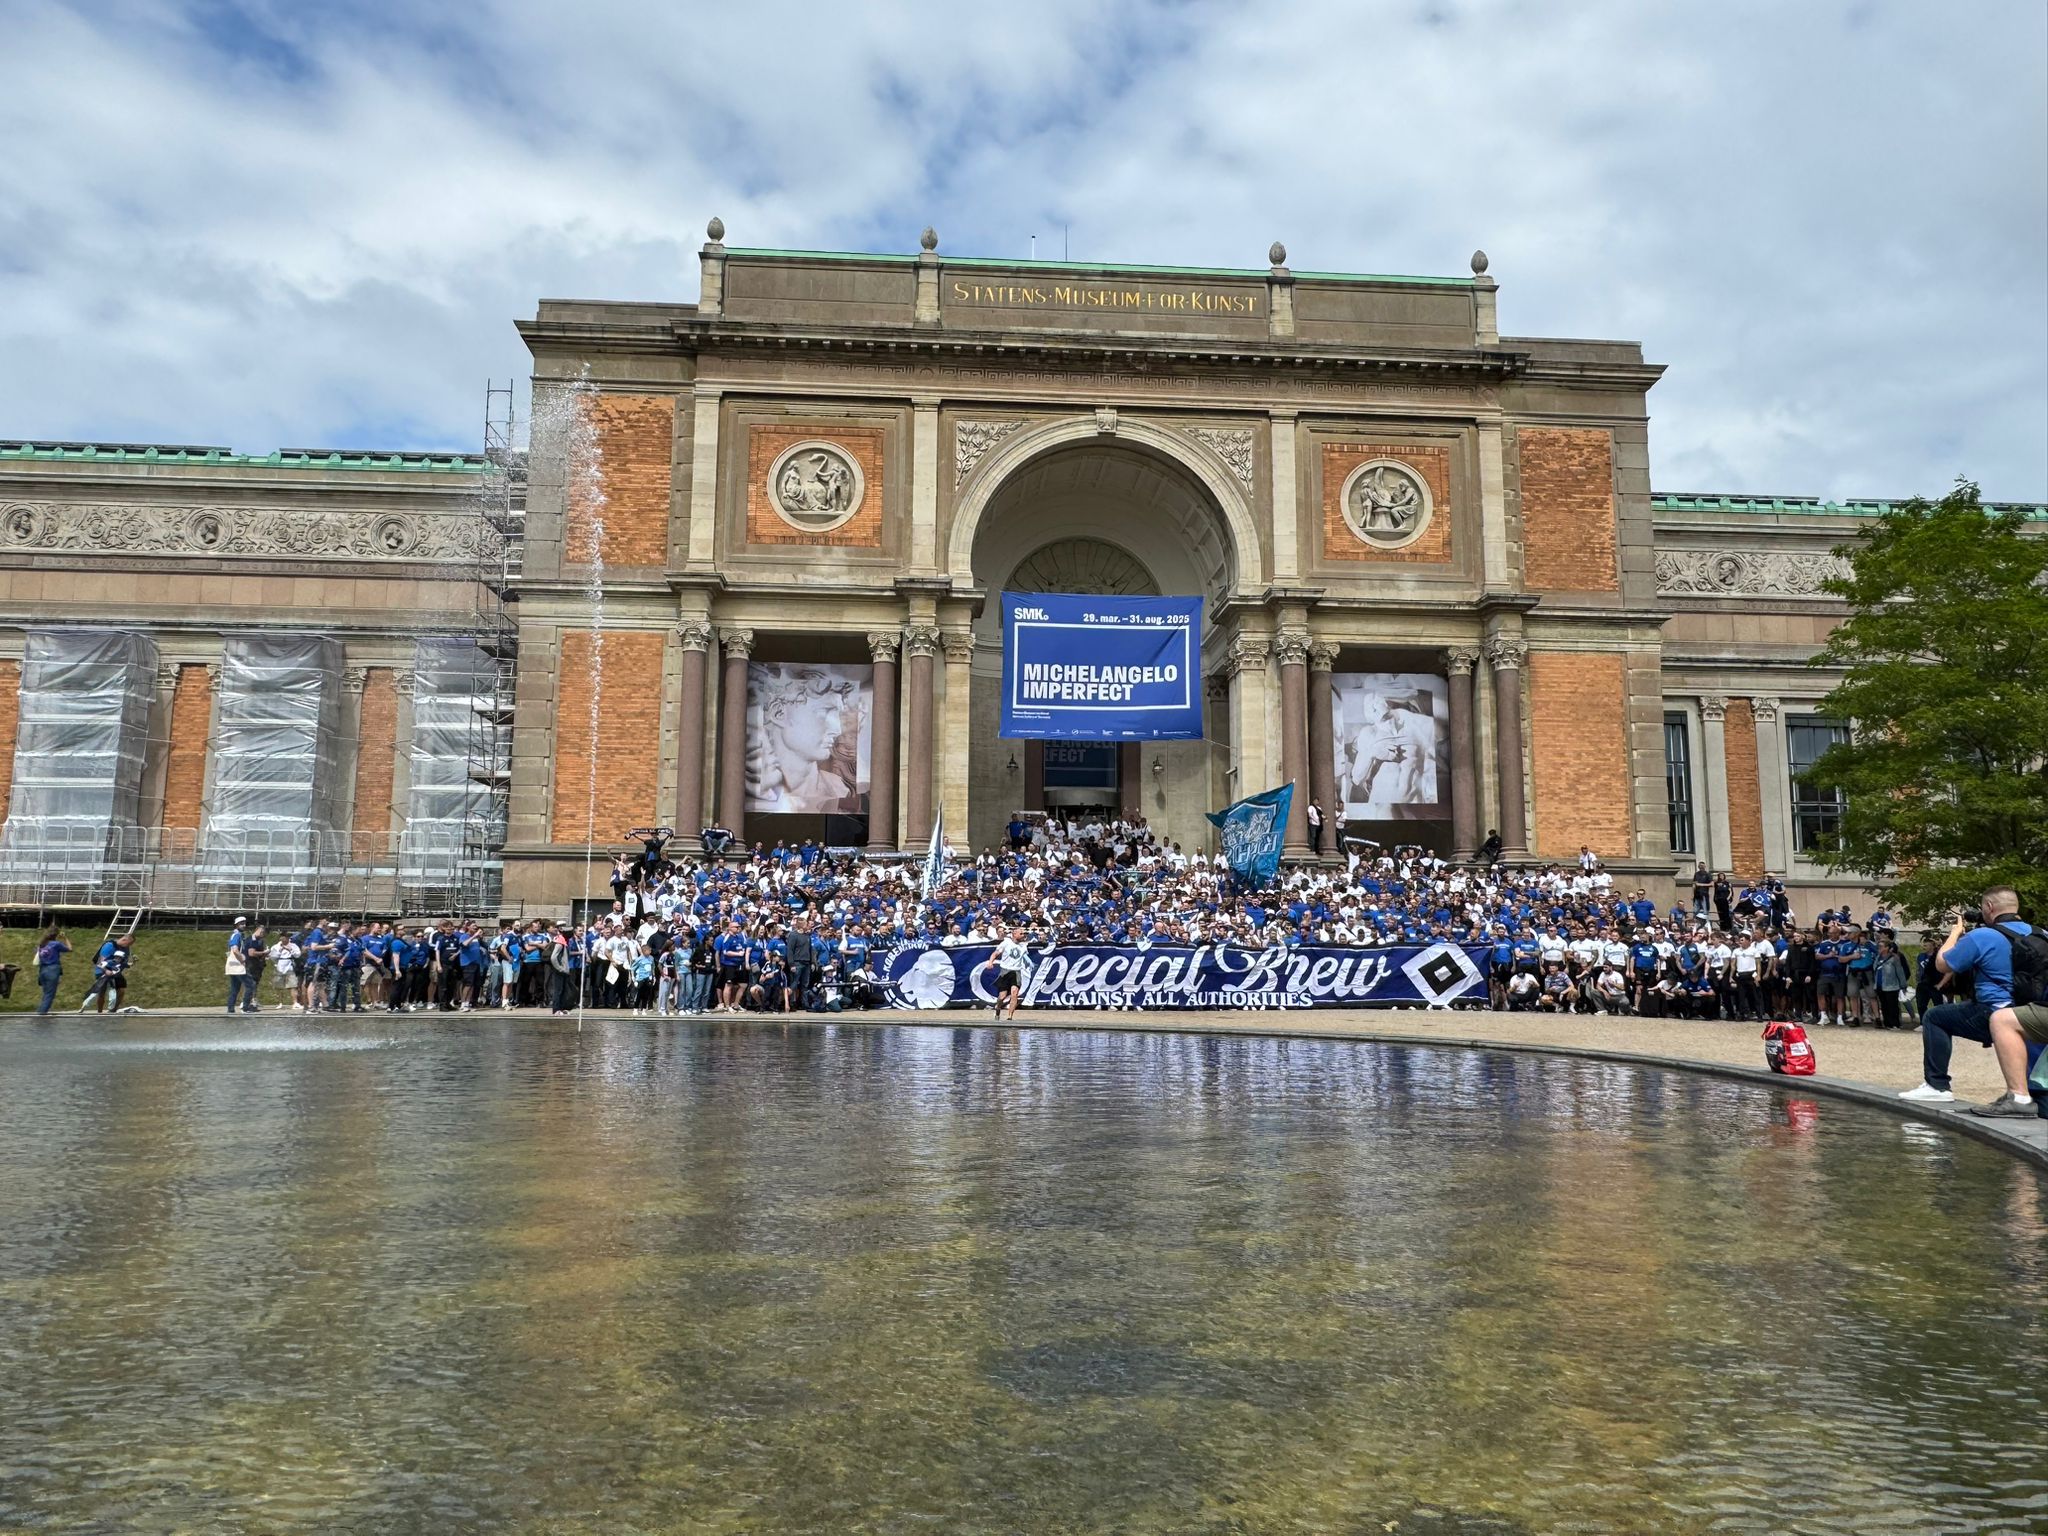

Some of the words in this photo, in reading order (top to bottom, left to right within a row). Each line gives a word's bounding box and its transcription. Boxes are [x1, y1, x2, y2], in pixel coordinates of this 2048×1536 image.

[954, 282, 1046, 304] STATENS
[1055, 286, 1139, 308] MUSEUM
[1191, 291, 1257, 312] KUNST
[1100, 615, 1121, 623] mar.
[1130, 614, 1143, 624] 31.
[1145, 615, 1165, 626] aug.
[1167, 614, 1190, 624] 2025
[1024, 663, 1178, 684] MICHELANGELO
[1023, 683, 1134, 701] IMPERFECT
[1050, 991, 1135, 1006] AGAINST
[1141, 991, 1180, 1006] ALL
[1186, 991, 1313, 1007] AUTHORITIES
